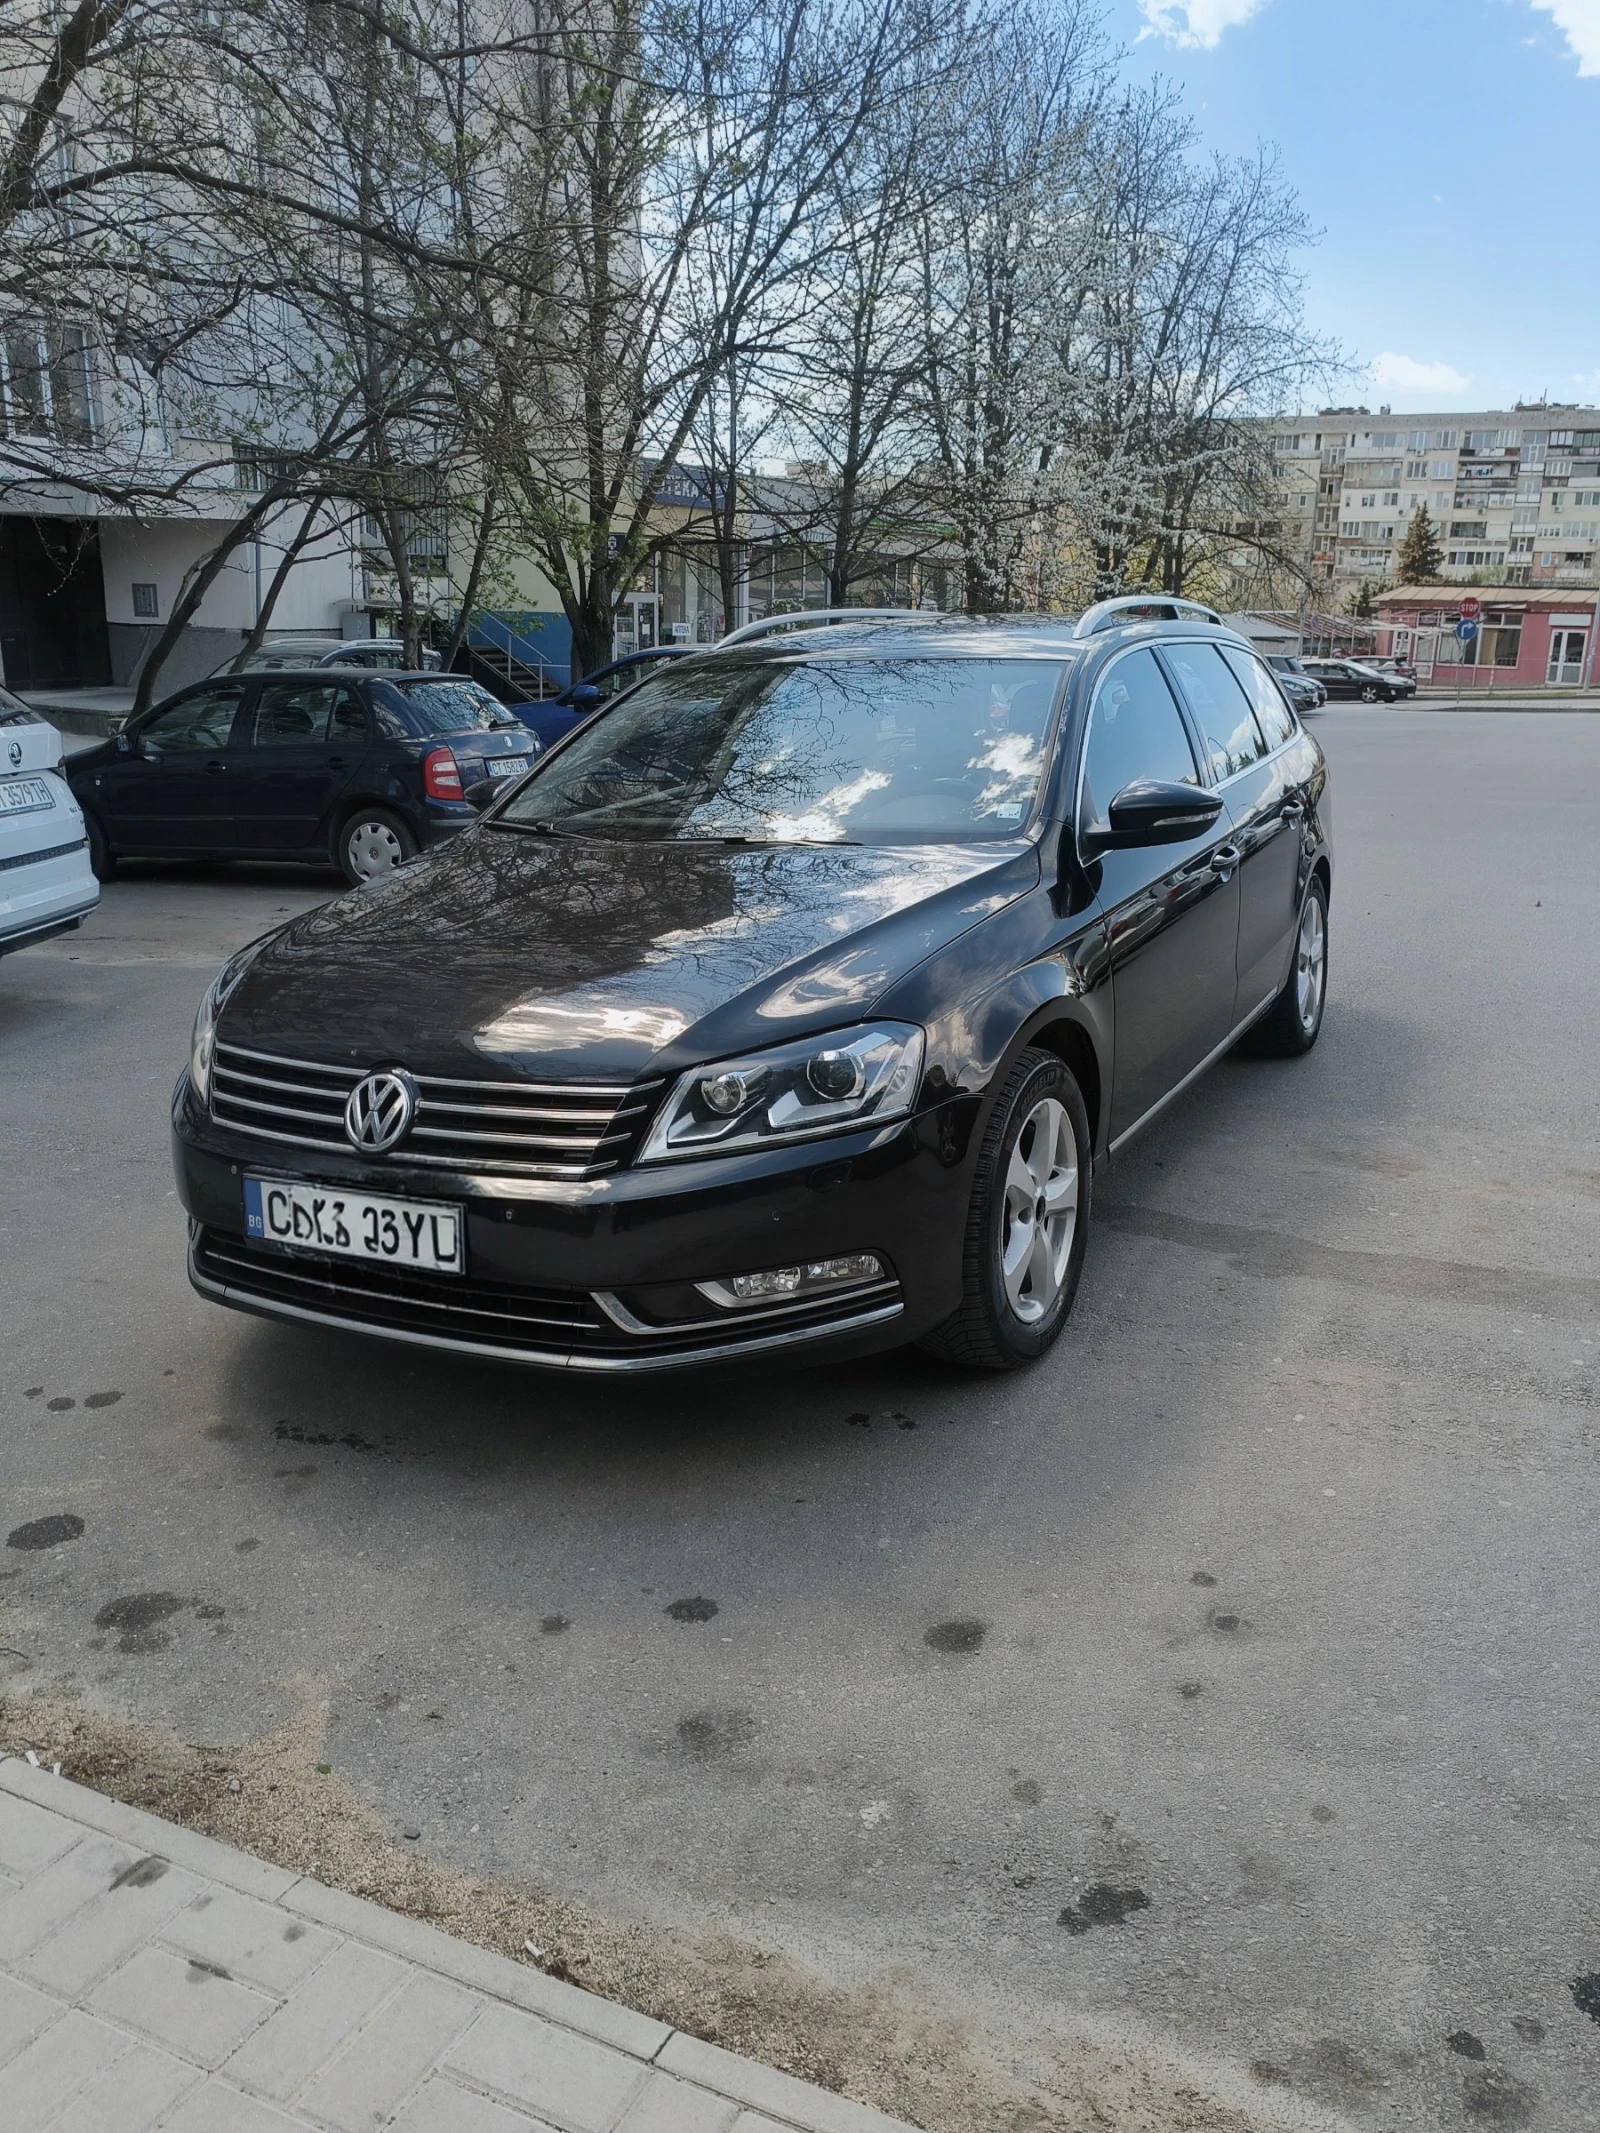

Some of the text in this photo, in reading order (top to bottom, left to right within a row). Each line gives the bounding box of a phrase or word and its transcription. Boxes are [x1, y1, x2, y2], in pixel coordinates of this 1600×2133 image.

[1460, 603, 1479, 612] STOP
[3, 784, 34, 806] 3579
[30, 781, 51, 801] TH
[248, 1215, 262, 1229] BG
